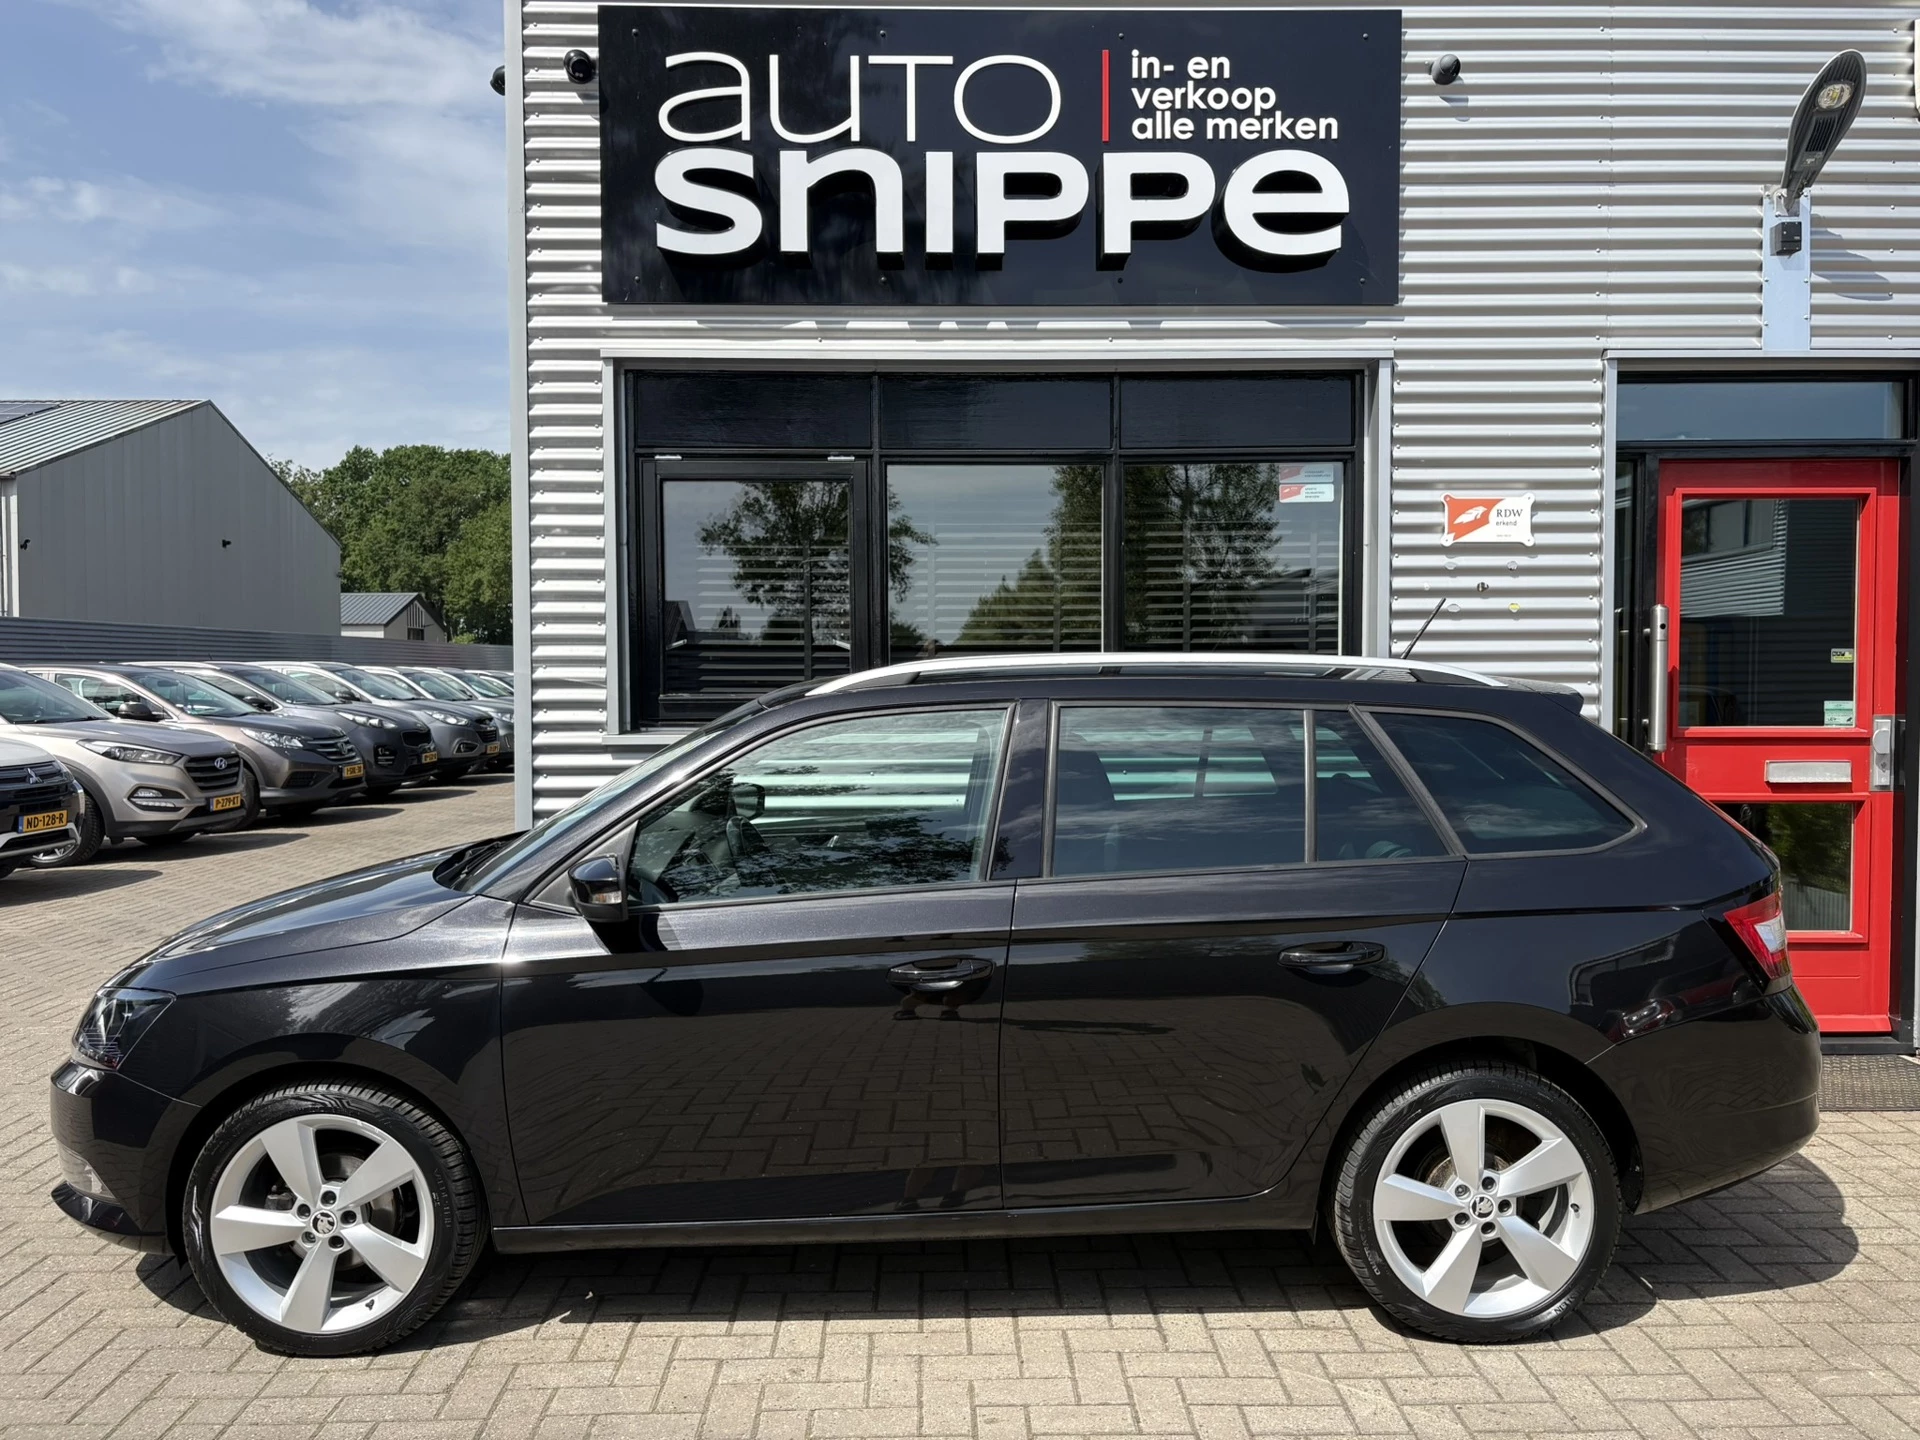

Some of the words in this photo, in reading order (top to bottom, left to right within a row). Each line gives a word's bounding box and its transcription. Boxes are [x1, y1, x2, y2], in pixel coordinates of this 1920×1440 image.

[1131, 49, 1175, 79] in-
[1187, 56, 1230, 79] en
[1131, 80, 1276, 116] verkoop
[1131, 110, 1195, 140] alle
[1206, 110, 1338, 140] merken
[1496, 508, 1523, 518] RDW
[26, 812, 65, 830] ND-128-R
